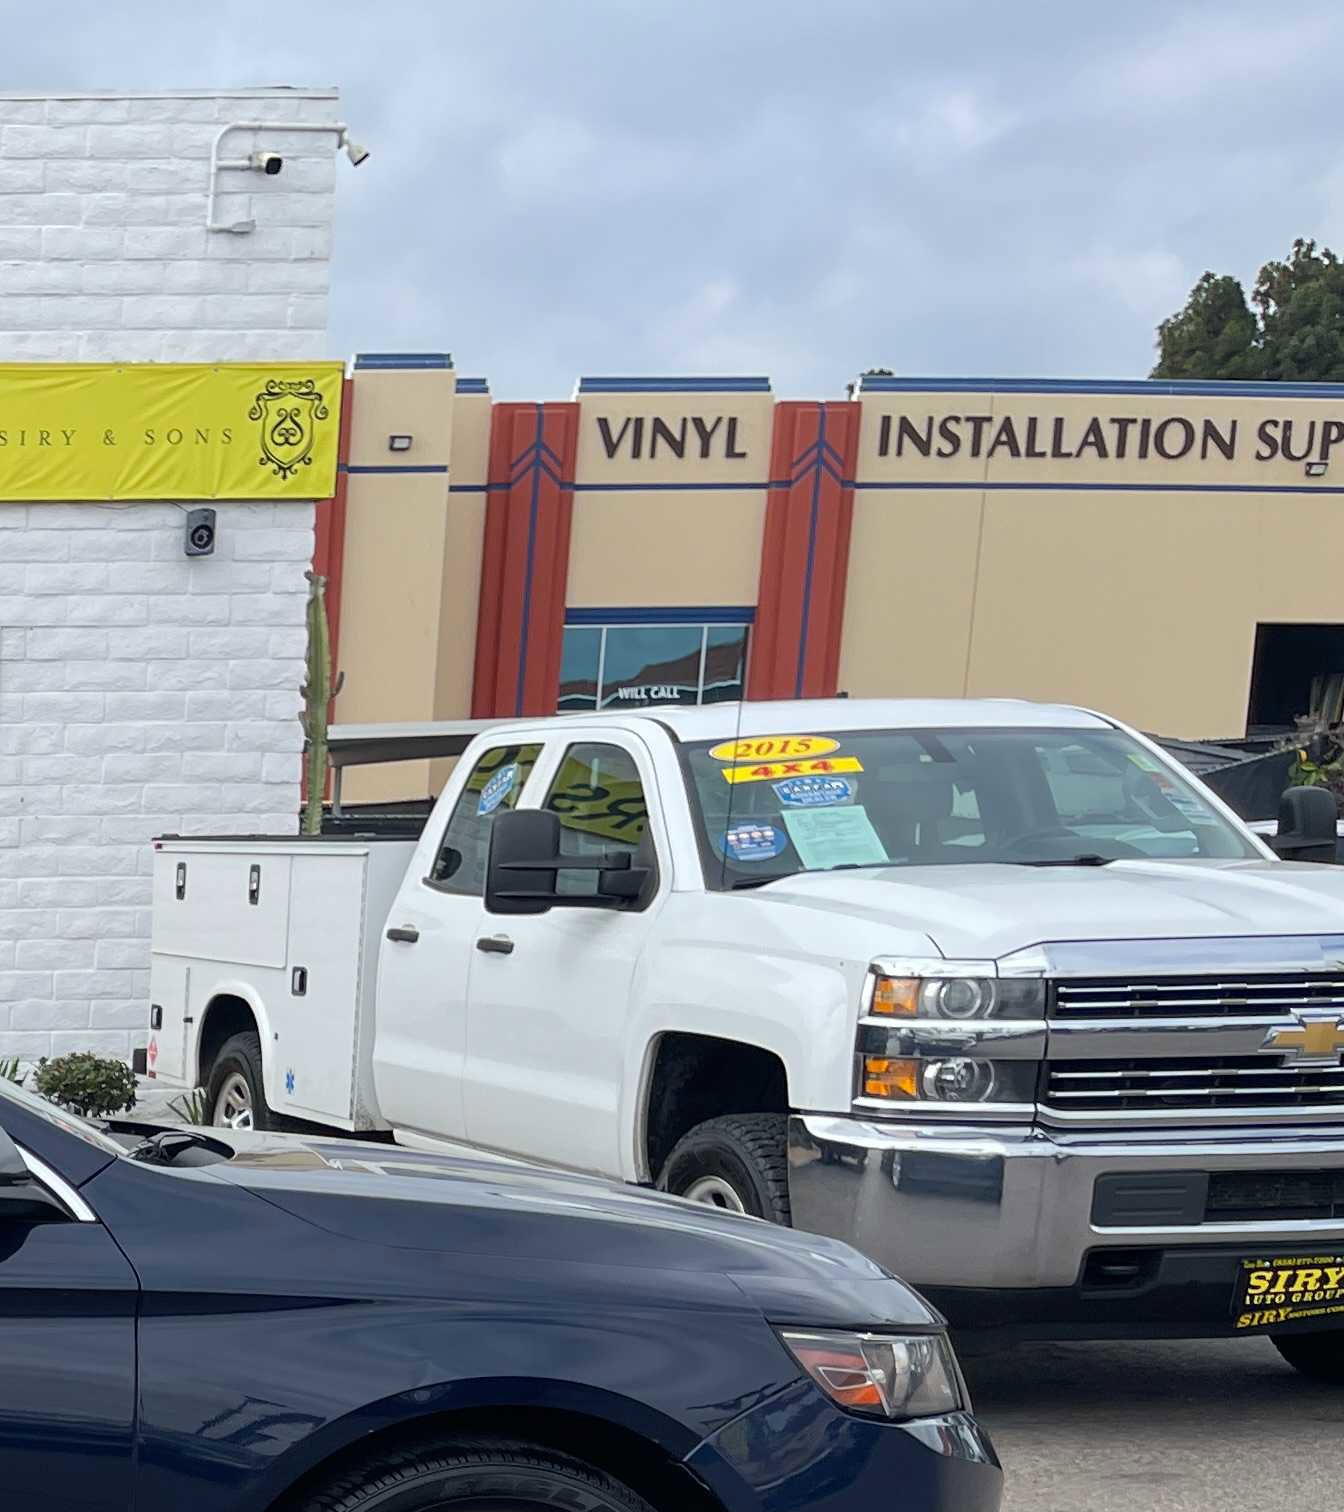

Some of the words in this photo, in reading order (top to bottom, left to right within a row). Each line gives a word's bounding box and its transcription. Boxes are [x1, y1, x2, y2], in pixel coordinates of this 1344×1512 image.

[103, 429, 117, 446] &
[144, 428, 233, 446] SONS
[597, 416, 748, 460] VINYL
[877, 415, 1238, 462] INSTALLATION
[617, 687, 648, 700] WILL
[650, 686, 681, 699] CALL
[735, 738, 813, 758] 2015
